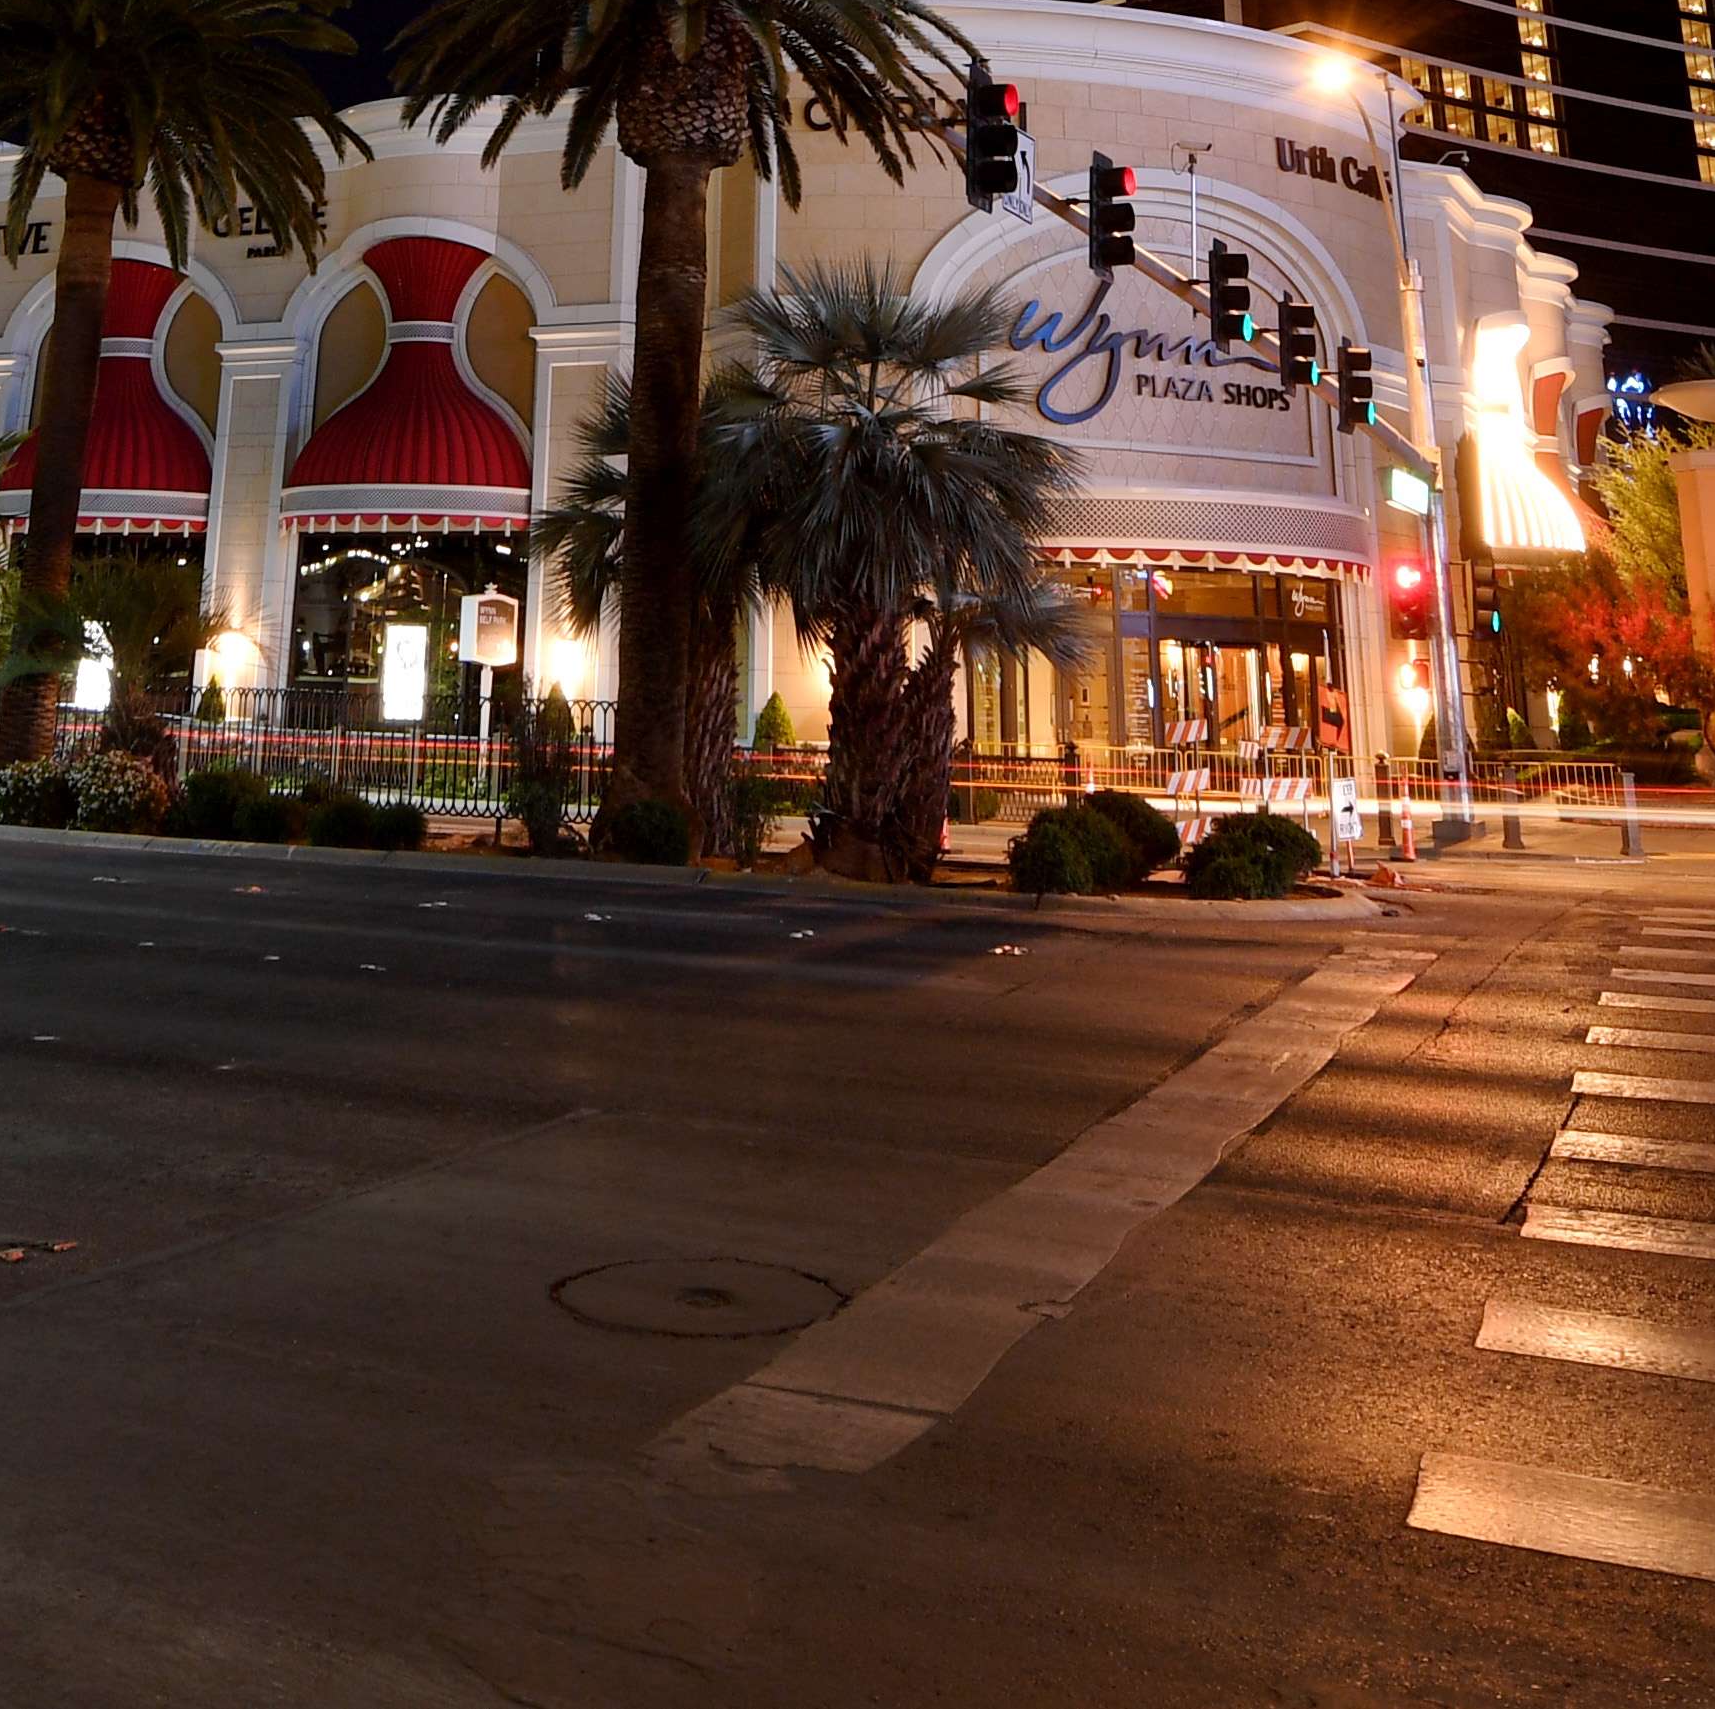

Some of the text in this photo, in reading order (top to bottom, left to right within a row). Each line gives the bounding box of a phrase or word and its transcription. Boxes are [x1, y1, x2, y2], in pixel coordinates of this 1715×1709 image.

[1276, 137, 1393, 204] Urth Caf
[212, 199, 329, 237] CELE
[1009, 275, 1280, 425] Wynn
[1136, 374, 1291, 412] PLAZA SHOPS
